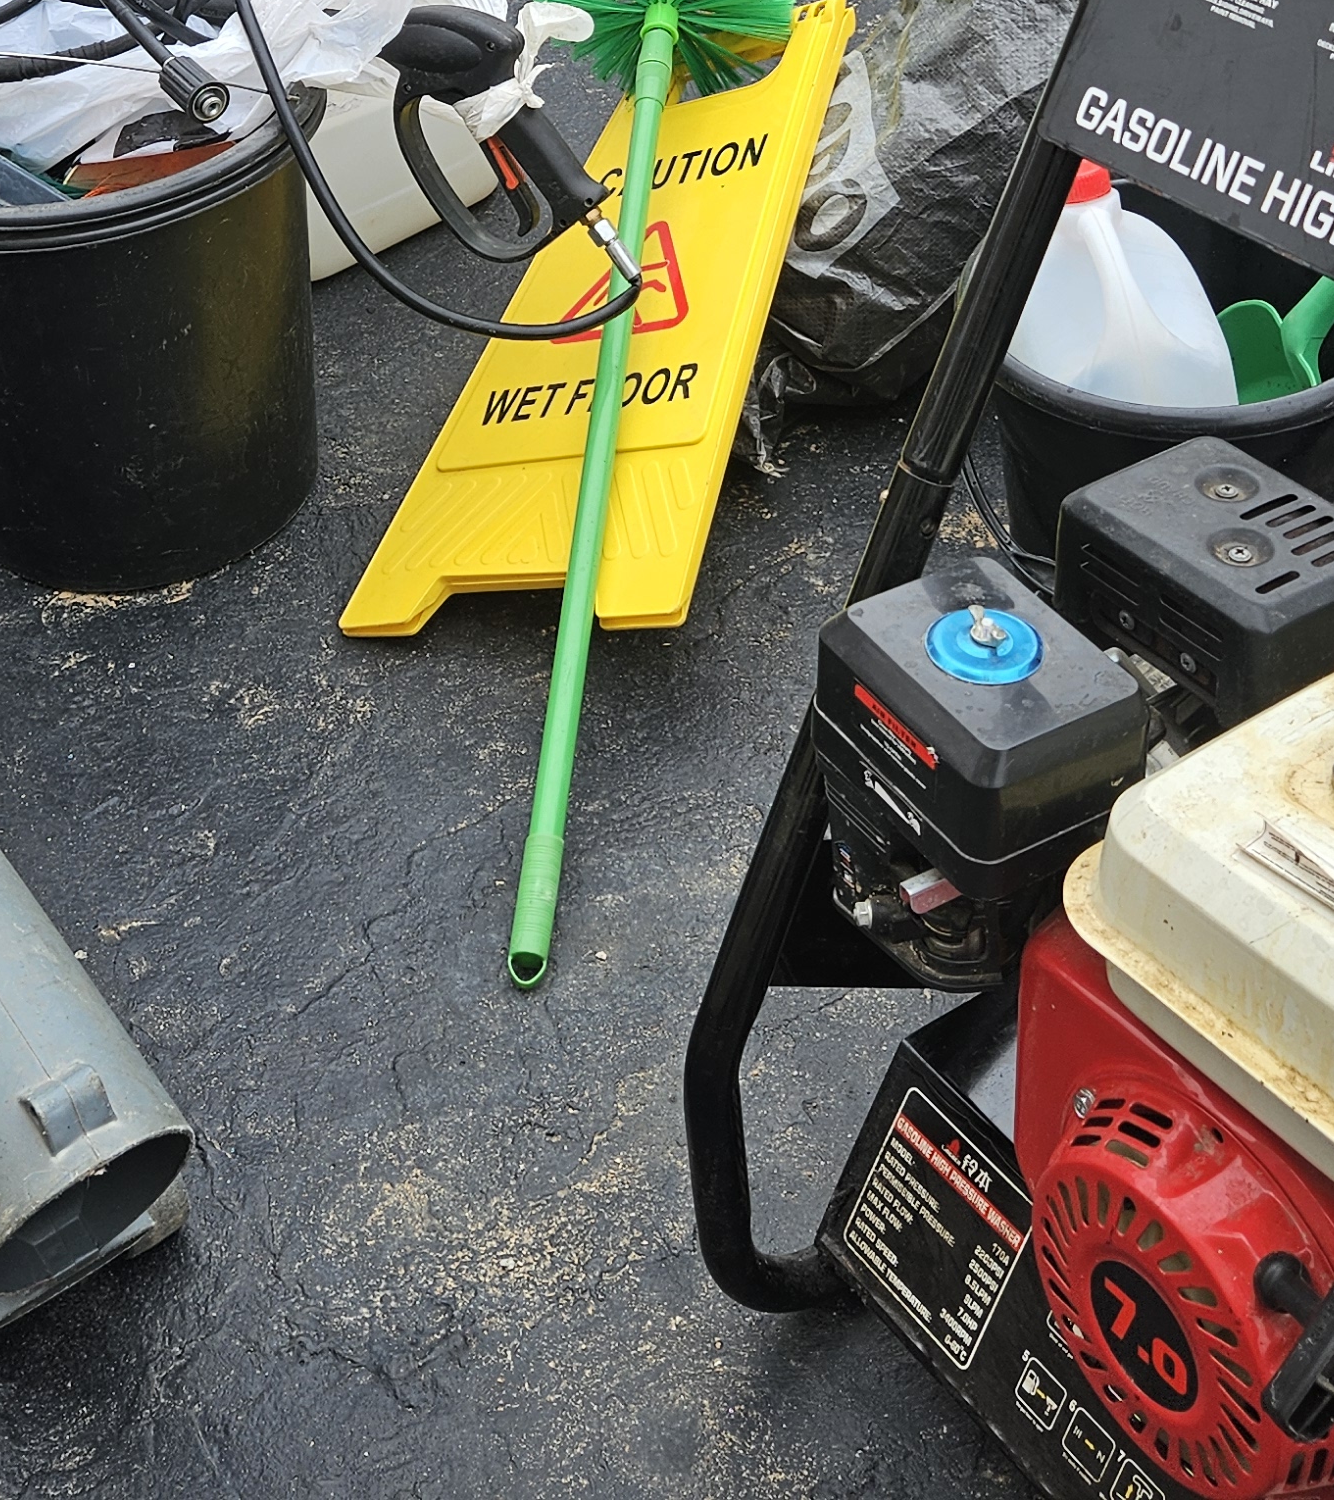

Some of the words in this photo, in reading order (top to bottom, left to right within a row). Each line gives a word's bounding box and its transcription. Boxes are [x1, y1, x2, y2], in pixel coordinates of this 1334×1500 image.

[1074, 85, 1266, 205] GASOLINE
[599, 133, 769, 202] CUTION
[481, 381, 568, 426] WET
[564, 362, 699, 416] FOOR
[884, 1151, 906, 1176] RATED
[872, 1175, 894, 1203] RATED
[876, 1163, 920, 1210] PERMISSIBLE
[894, 1117, 933, 1158] GASOLINE
[930, 1151, 951, 1176] HIGH
[949, 1170, 989, 1215] PRESSURE
[987, 1207, 1021, 1247] WASHER
[867, 1190, 884, 1211] MAX
[855, 1216, 876, 1242] RATED
[849, 1230, 887, 1273] ALLOWABLE
[992, 1243, 1009, 1266] 170A
[1100, 1276, 1189, 1396] 7.0
[1021, 1349, 1031, 1362] 5
[1068, 1399, 1078, 1413] 6
[1117, 1449, 1127, 1463] 7
